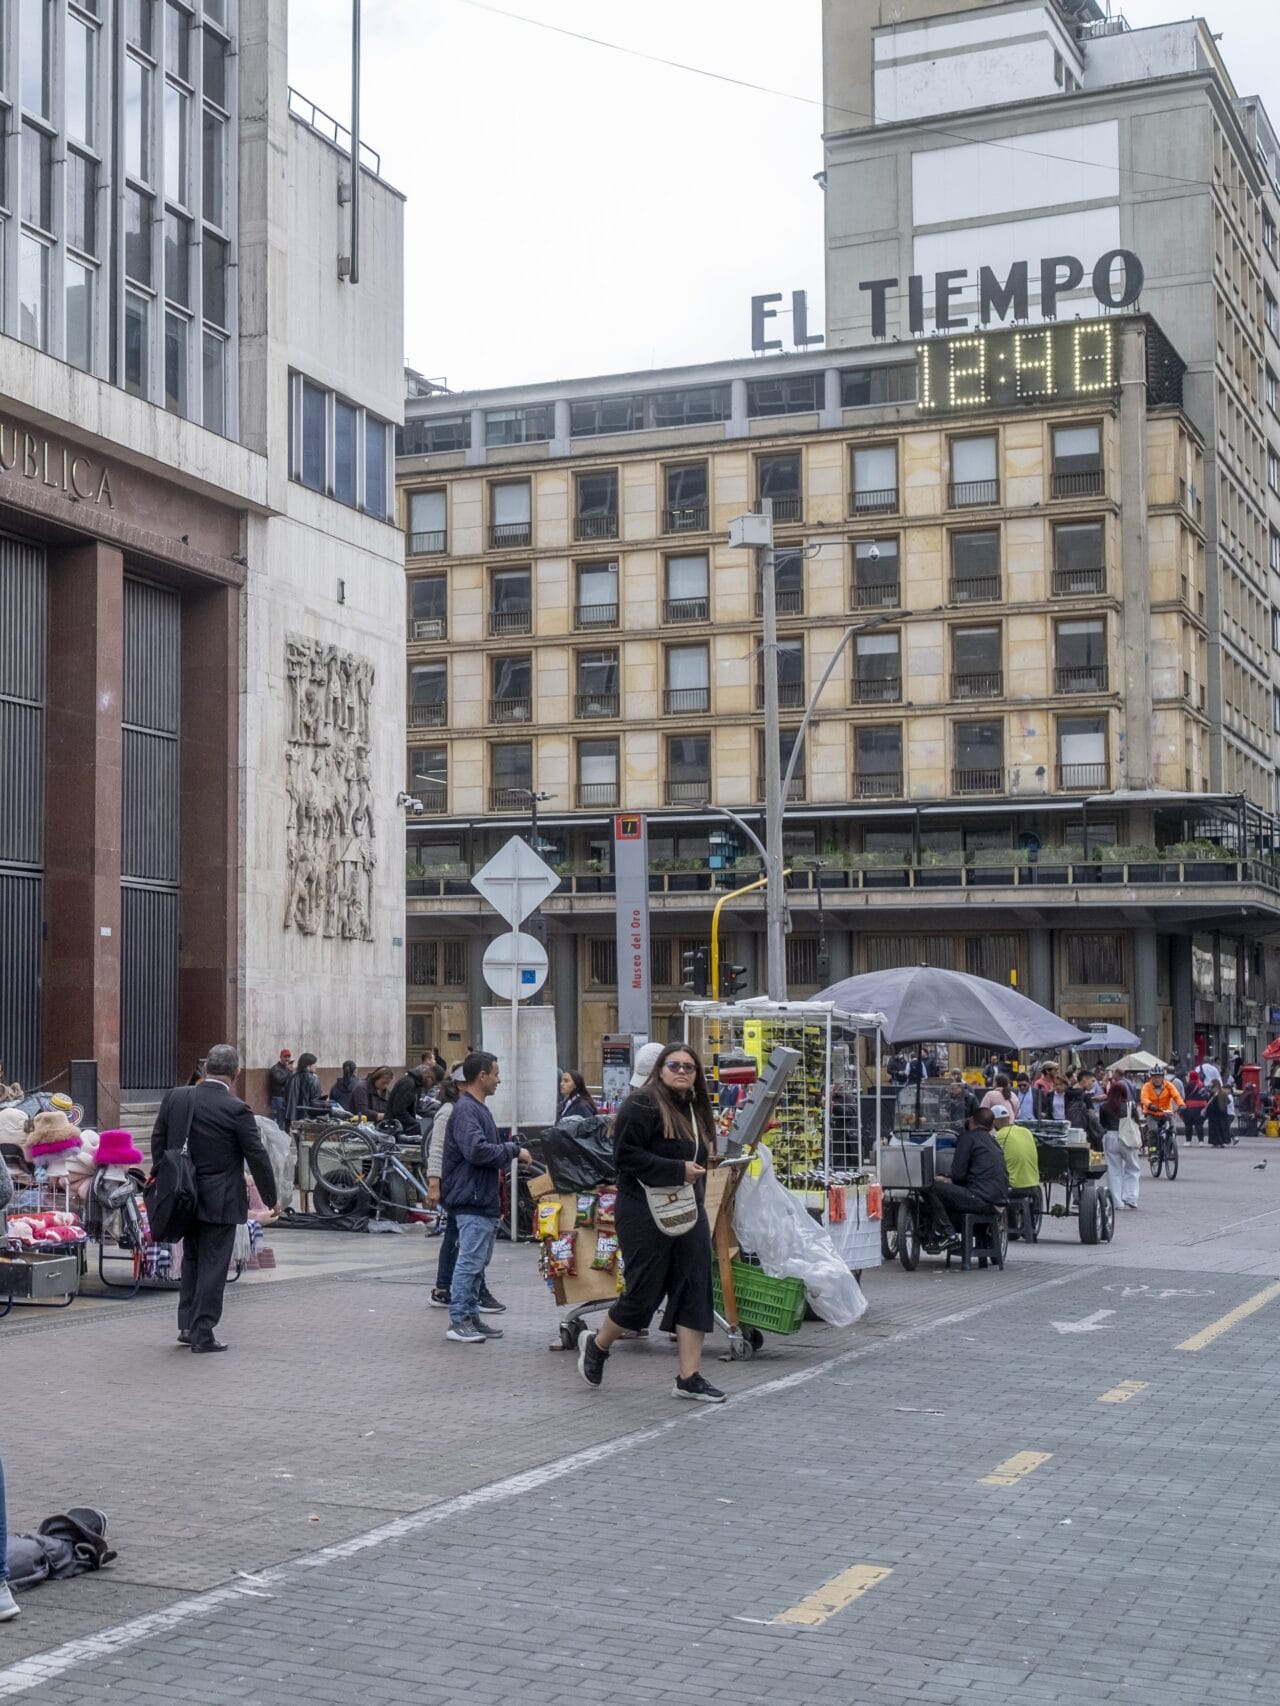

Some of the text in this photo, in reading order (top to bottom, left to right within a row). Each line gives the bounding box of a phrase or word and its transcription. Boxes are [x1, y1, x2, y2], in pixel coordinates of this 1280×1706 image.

[751, 249, 1144, 351] EL TIEMPO
[916, 323, 1114, 408] 12:40
[630, 909, 643, 989] Museo del Oro
